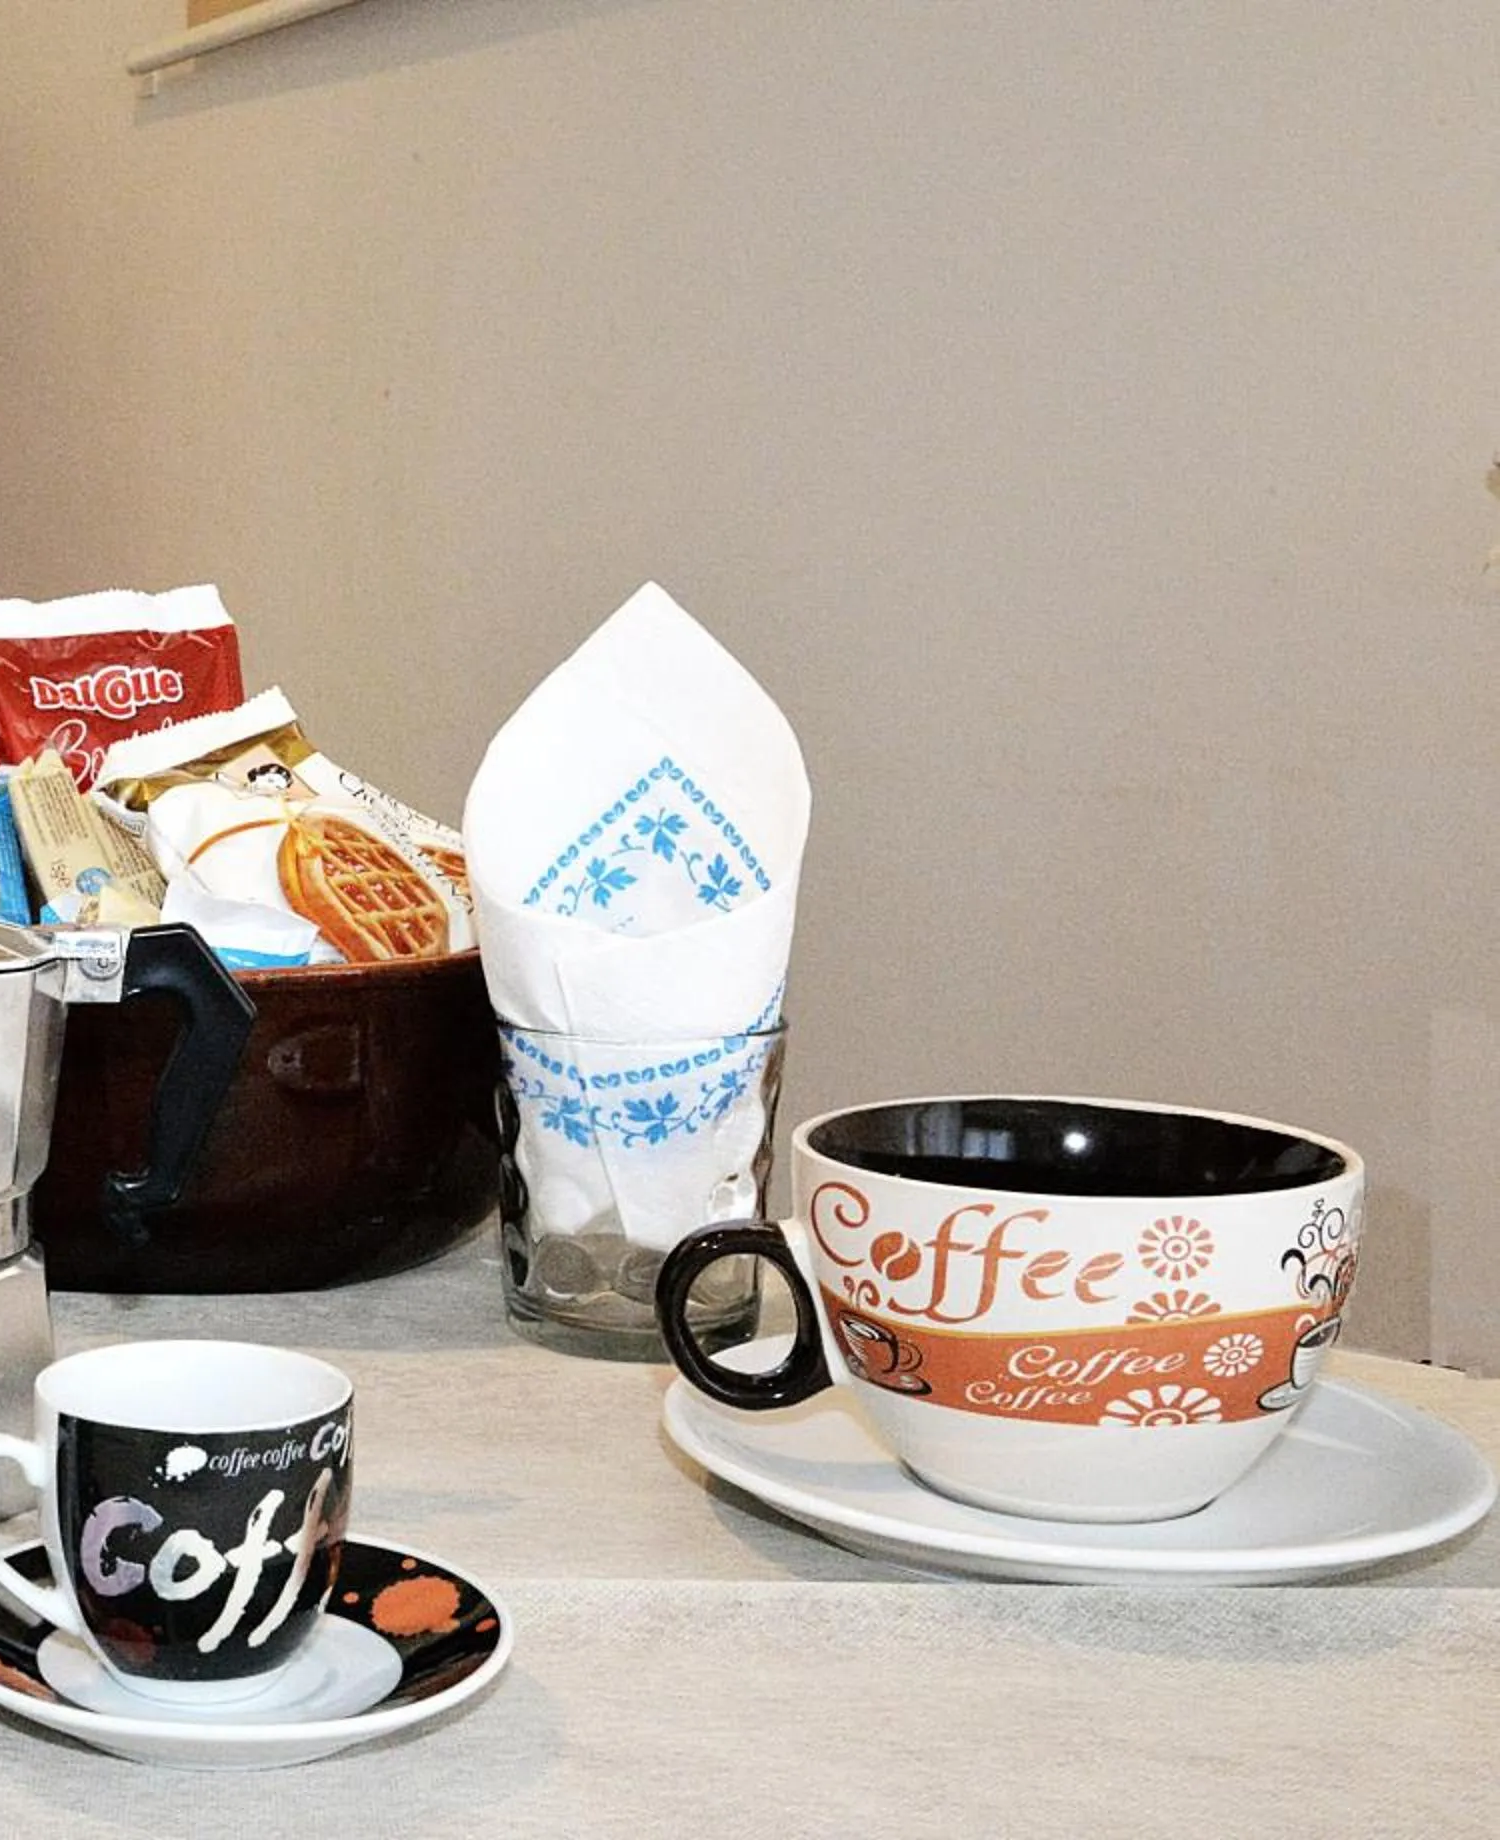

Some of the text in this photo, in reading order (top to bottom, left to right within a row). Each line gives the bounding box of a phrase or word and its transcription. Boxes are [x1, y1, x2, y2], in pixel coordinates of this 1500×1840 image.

[810, 1179, 1126, 1325] Coffee
[1006, 1344, 1189, 1387] Coffee
[963, 1378, 1093, 1413] Coffee
[208, 1447, 261, 1478] coffee
[262, 1438, 306, 1471] coffee
[80, 1467, 332, 1655] Coff
